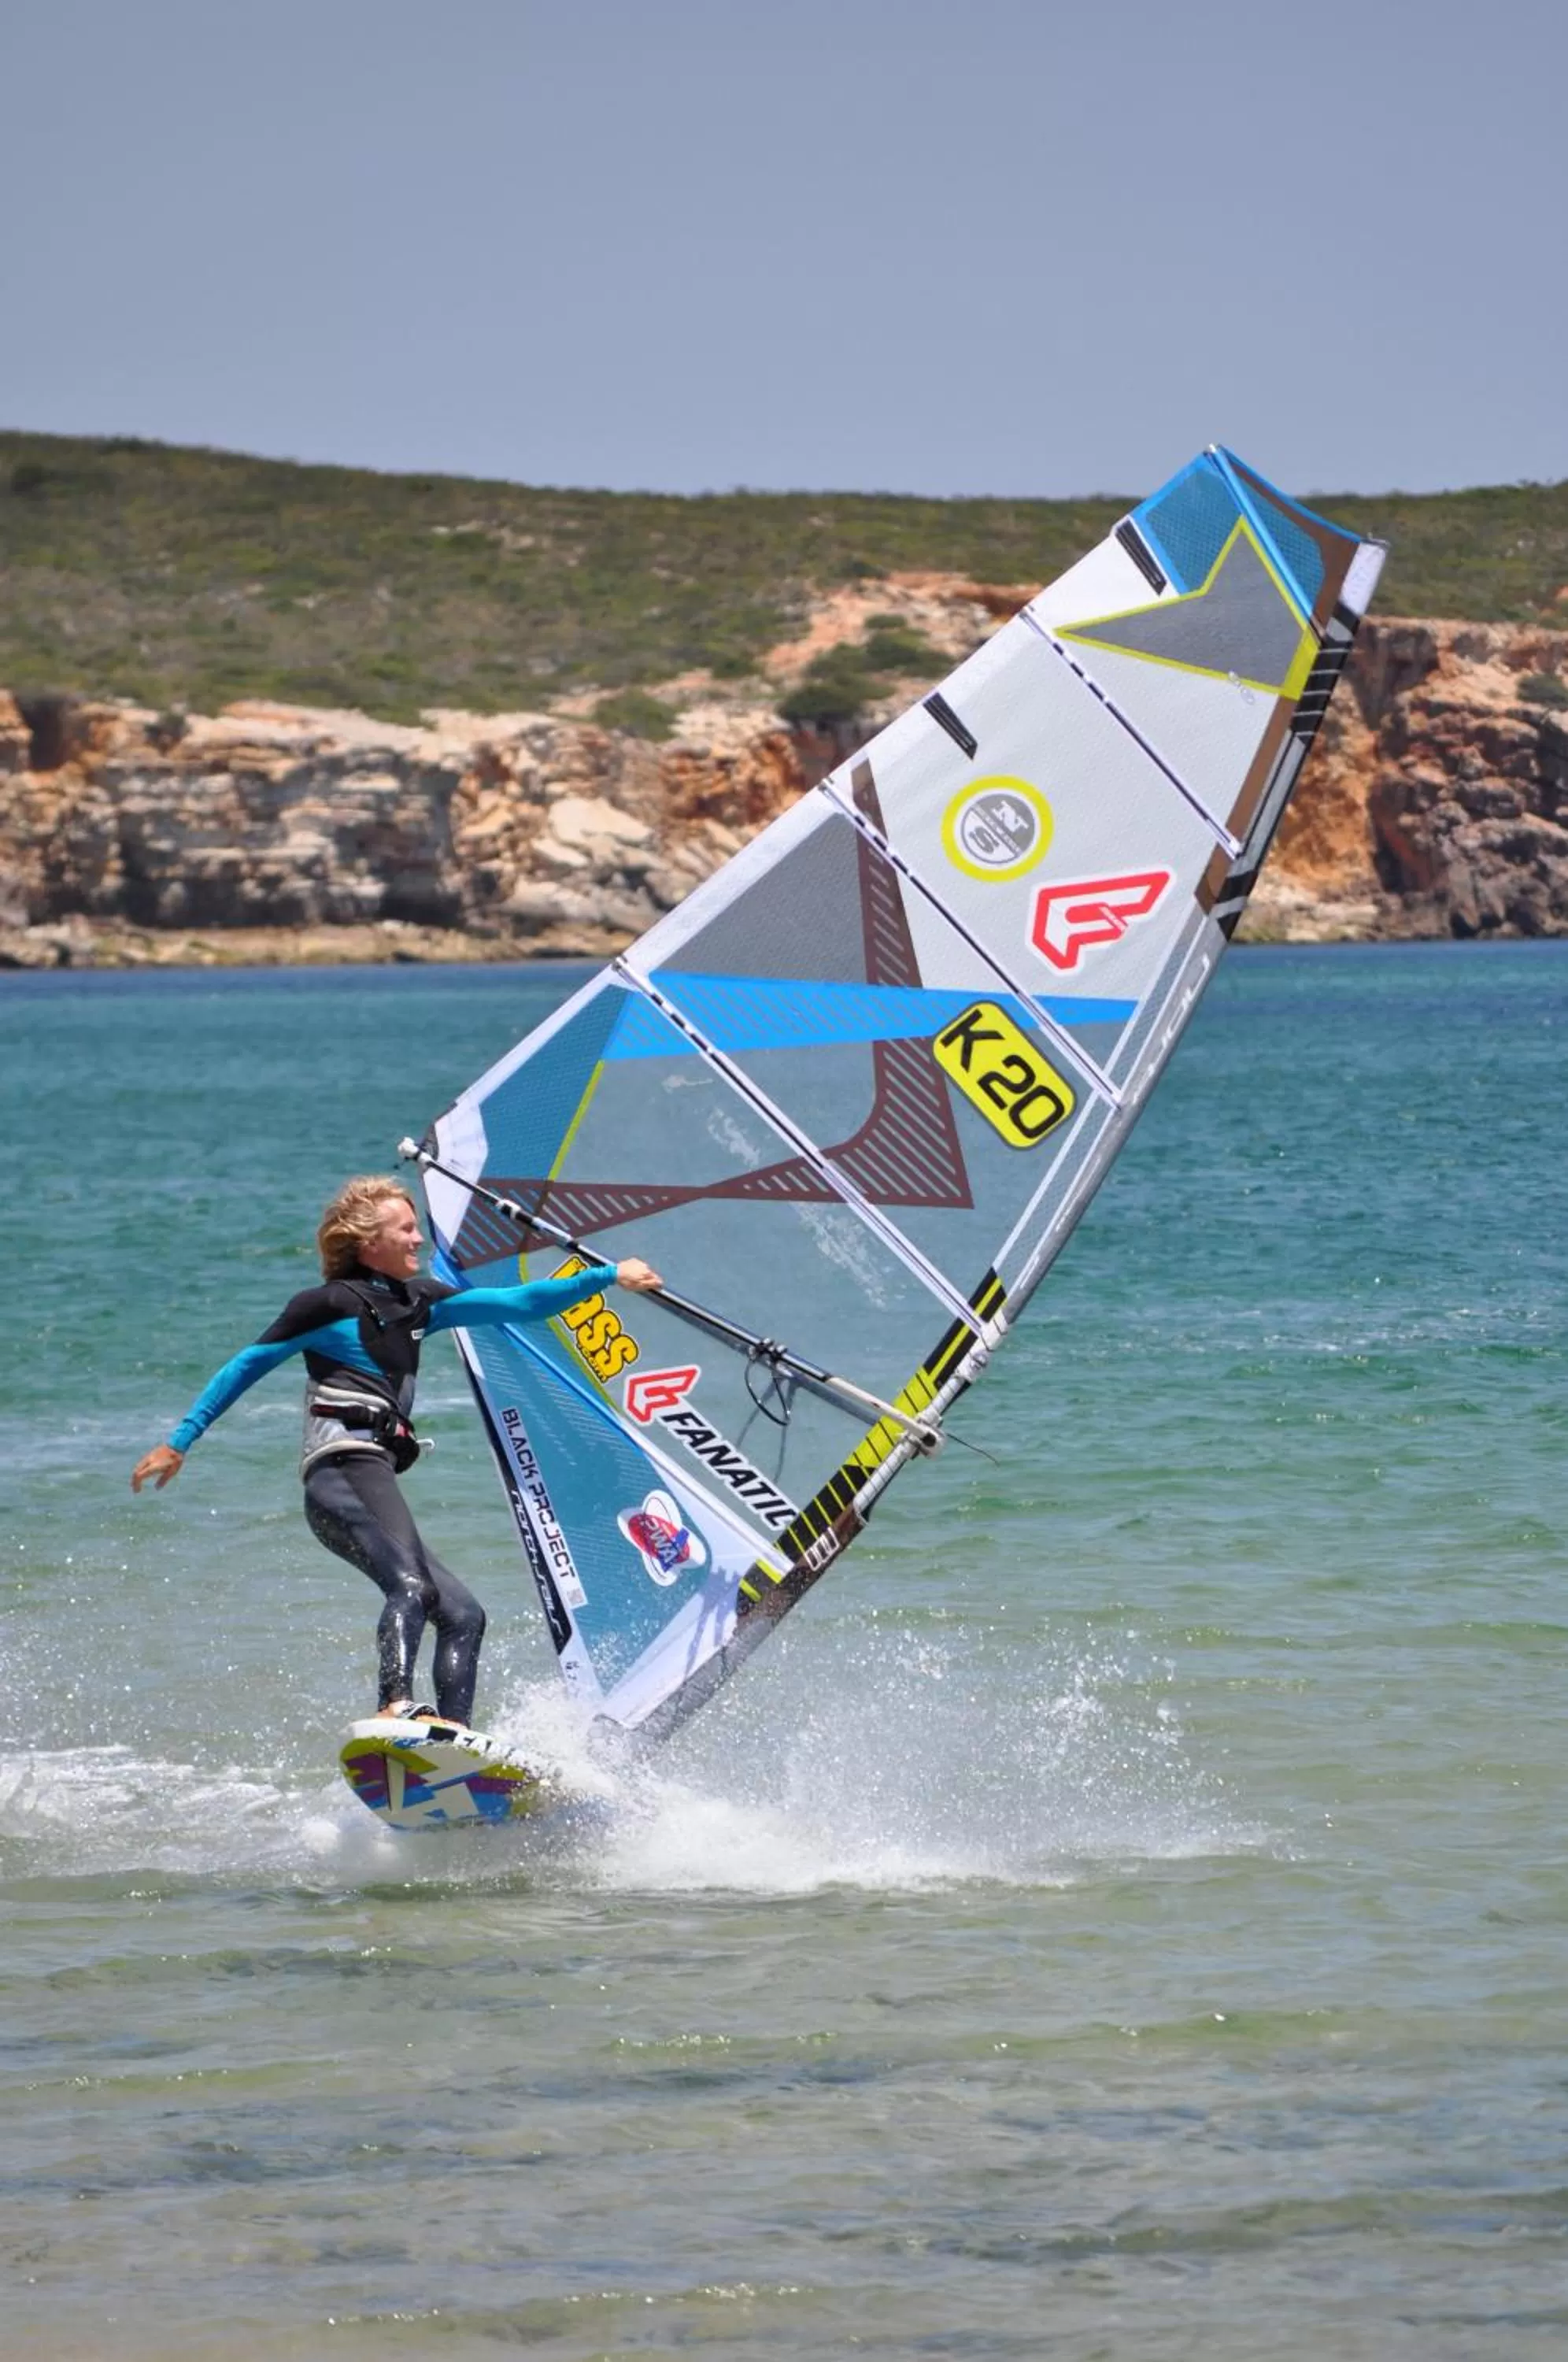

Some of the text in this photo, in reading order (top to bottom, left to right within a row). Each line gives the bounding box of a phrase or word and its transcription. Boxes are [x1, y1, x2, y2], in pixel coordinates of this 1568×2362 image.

[501, 1408, 575, 1579] BLACK PROJECT
[661, 1412, 797, 1526] FANATIC
